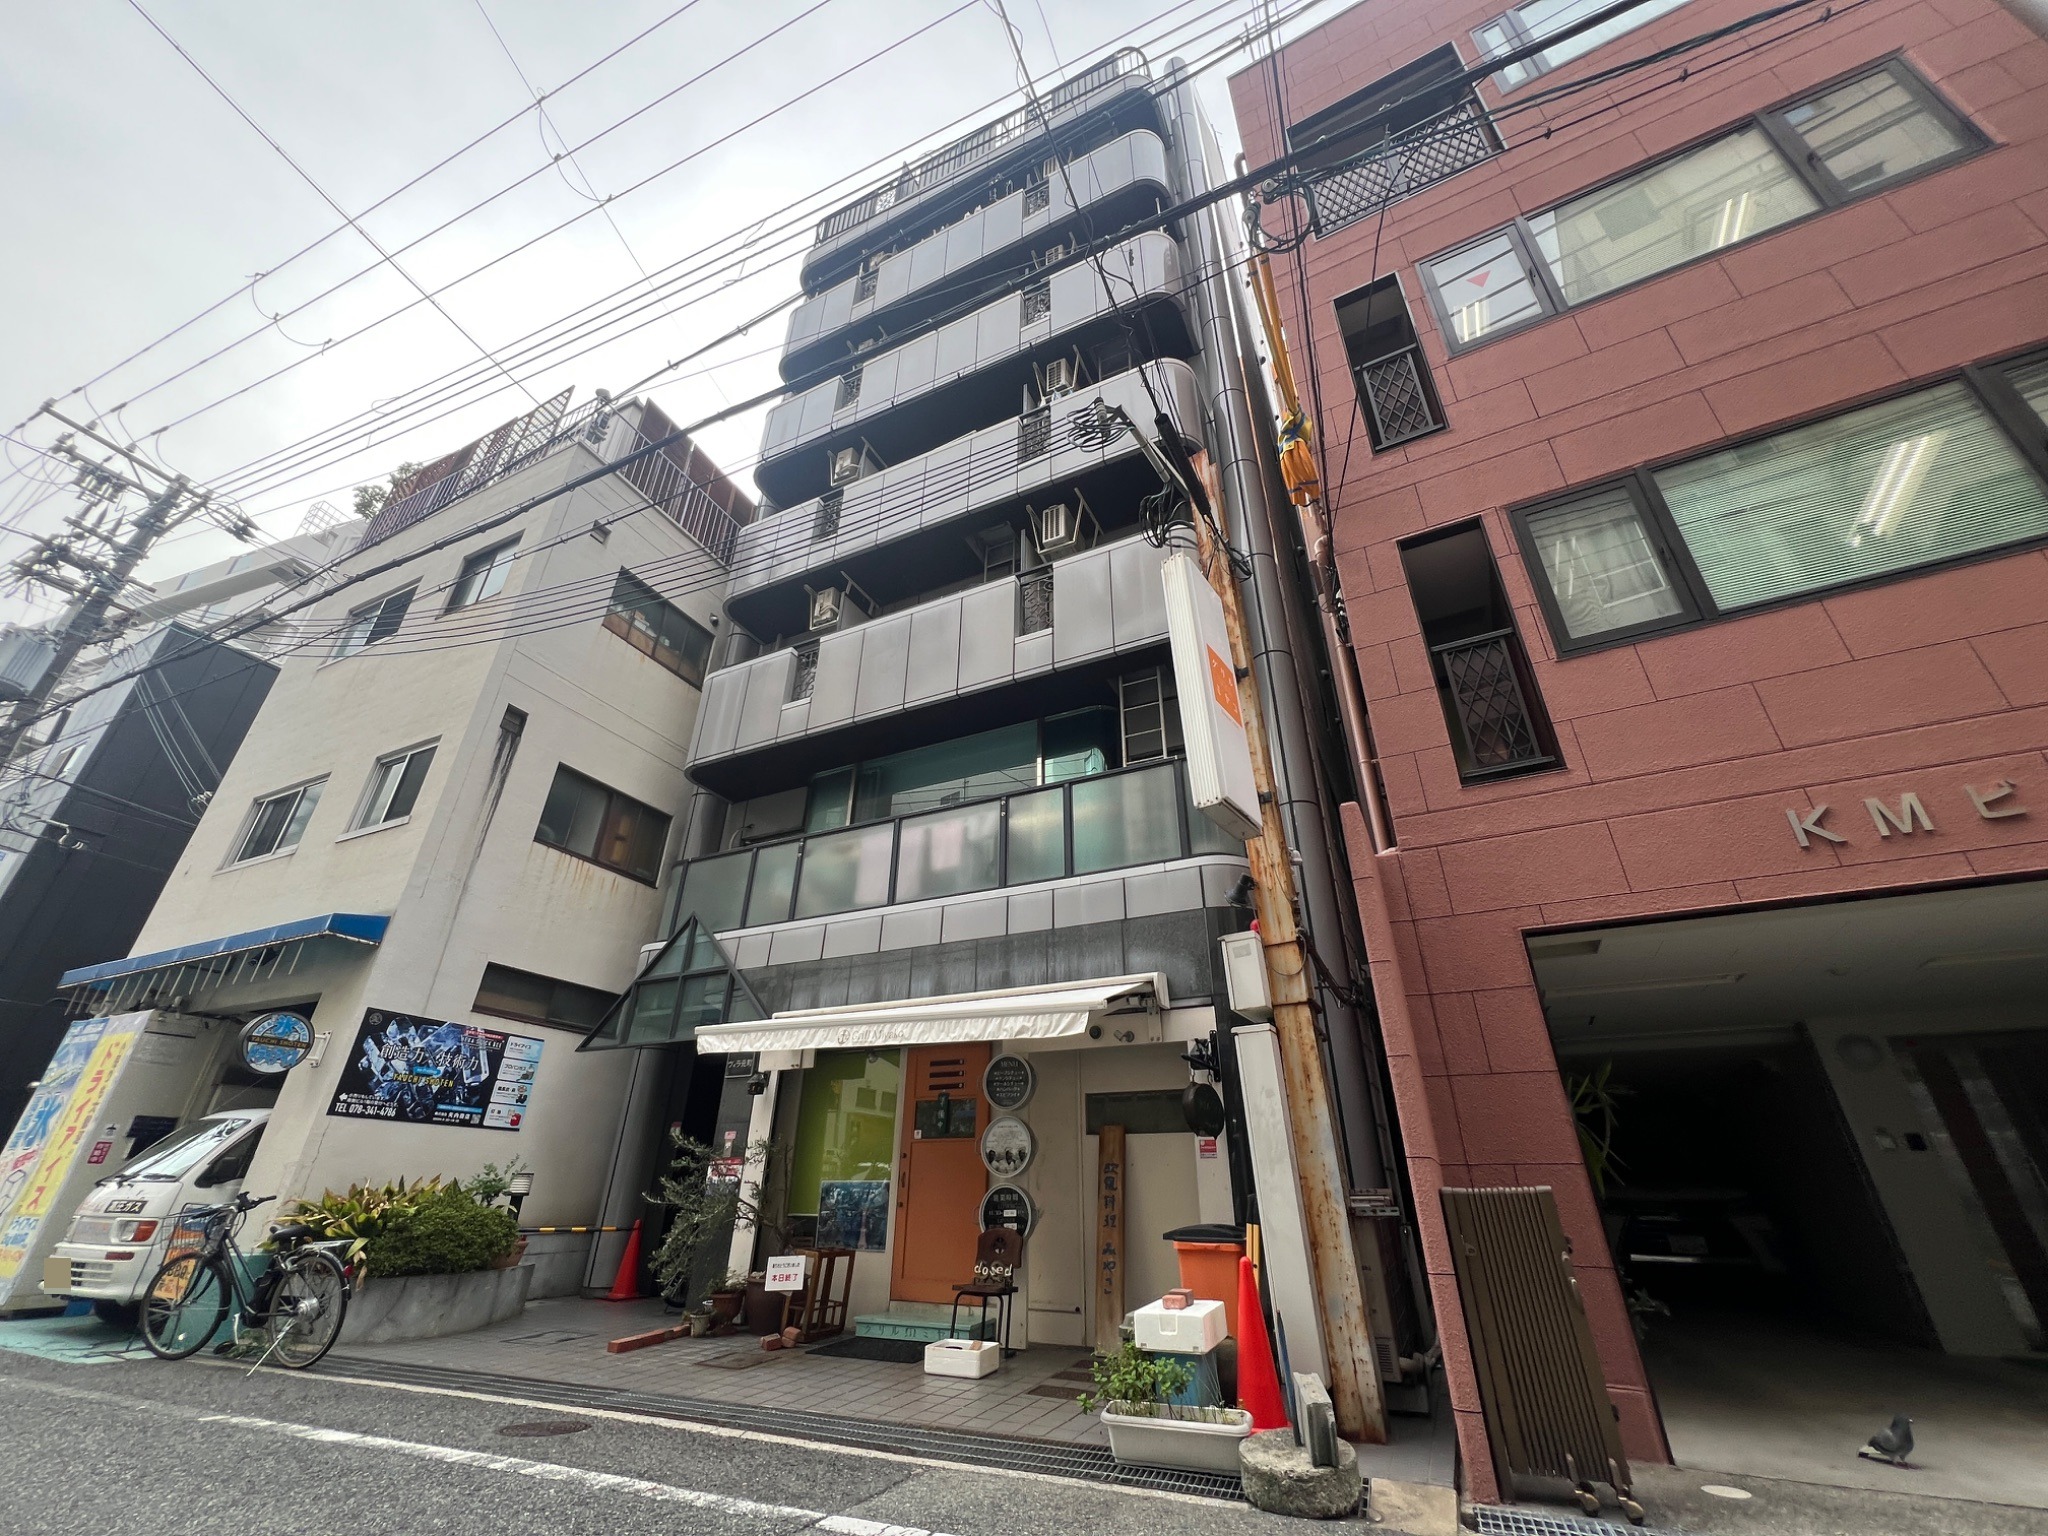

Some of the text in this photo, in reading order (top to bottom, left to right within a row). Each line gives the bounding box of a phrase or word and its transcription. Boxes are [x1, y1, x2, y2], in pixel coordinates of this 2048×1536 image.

[393, 1073, 454, 1088] TAUCHI SHOTEN
[334, 1102, 348, 1113] TEL
[349, 1104, 397, 1118] 078-341-4786
[26, 1041, 120, 1211] ドライアイス
[974, 1261, 1013, 1277] closed
[771, 1273, 798, 1282] 本日終了
